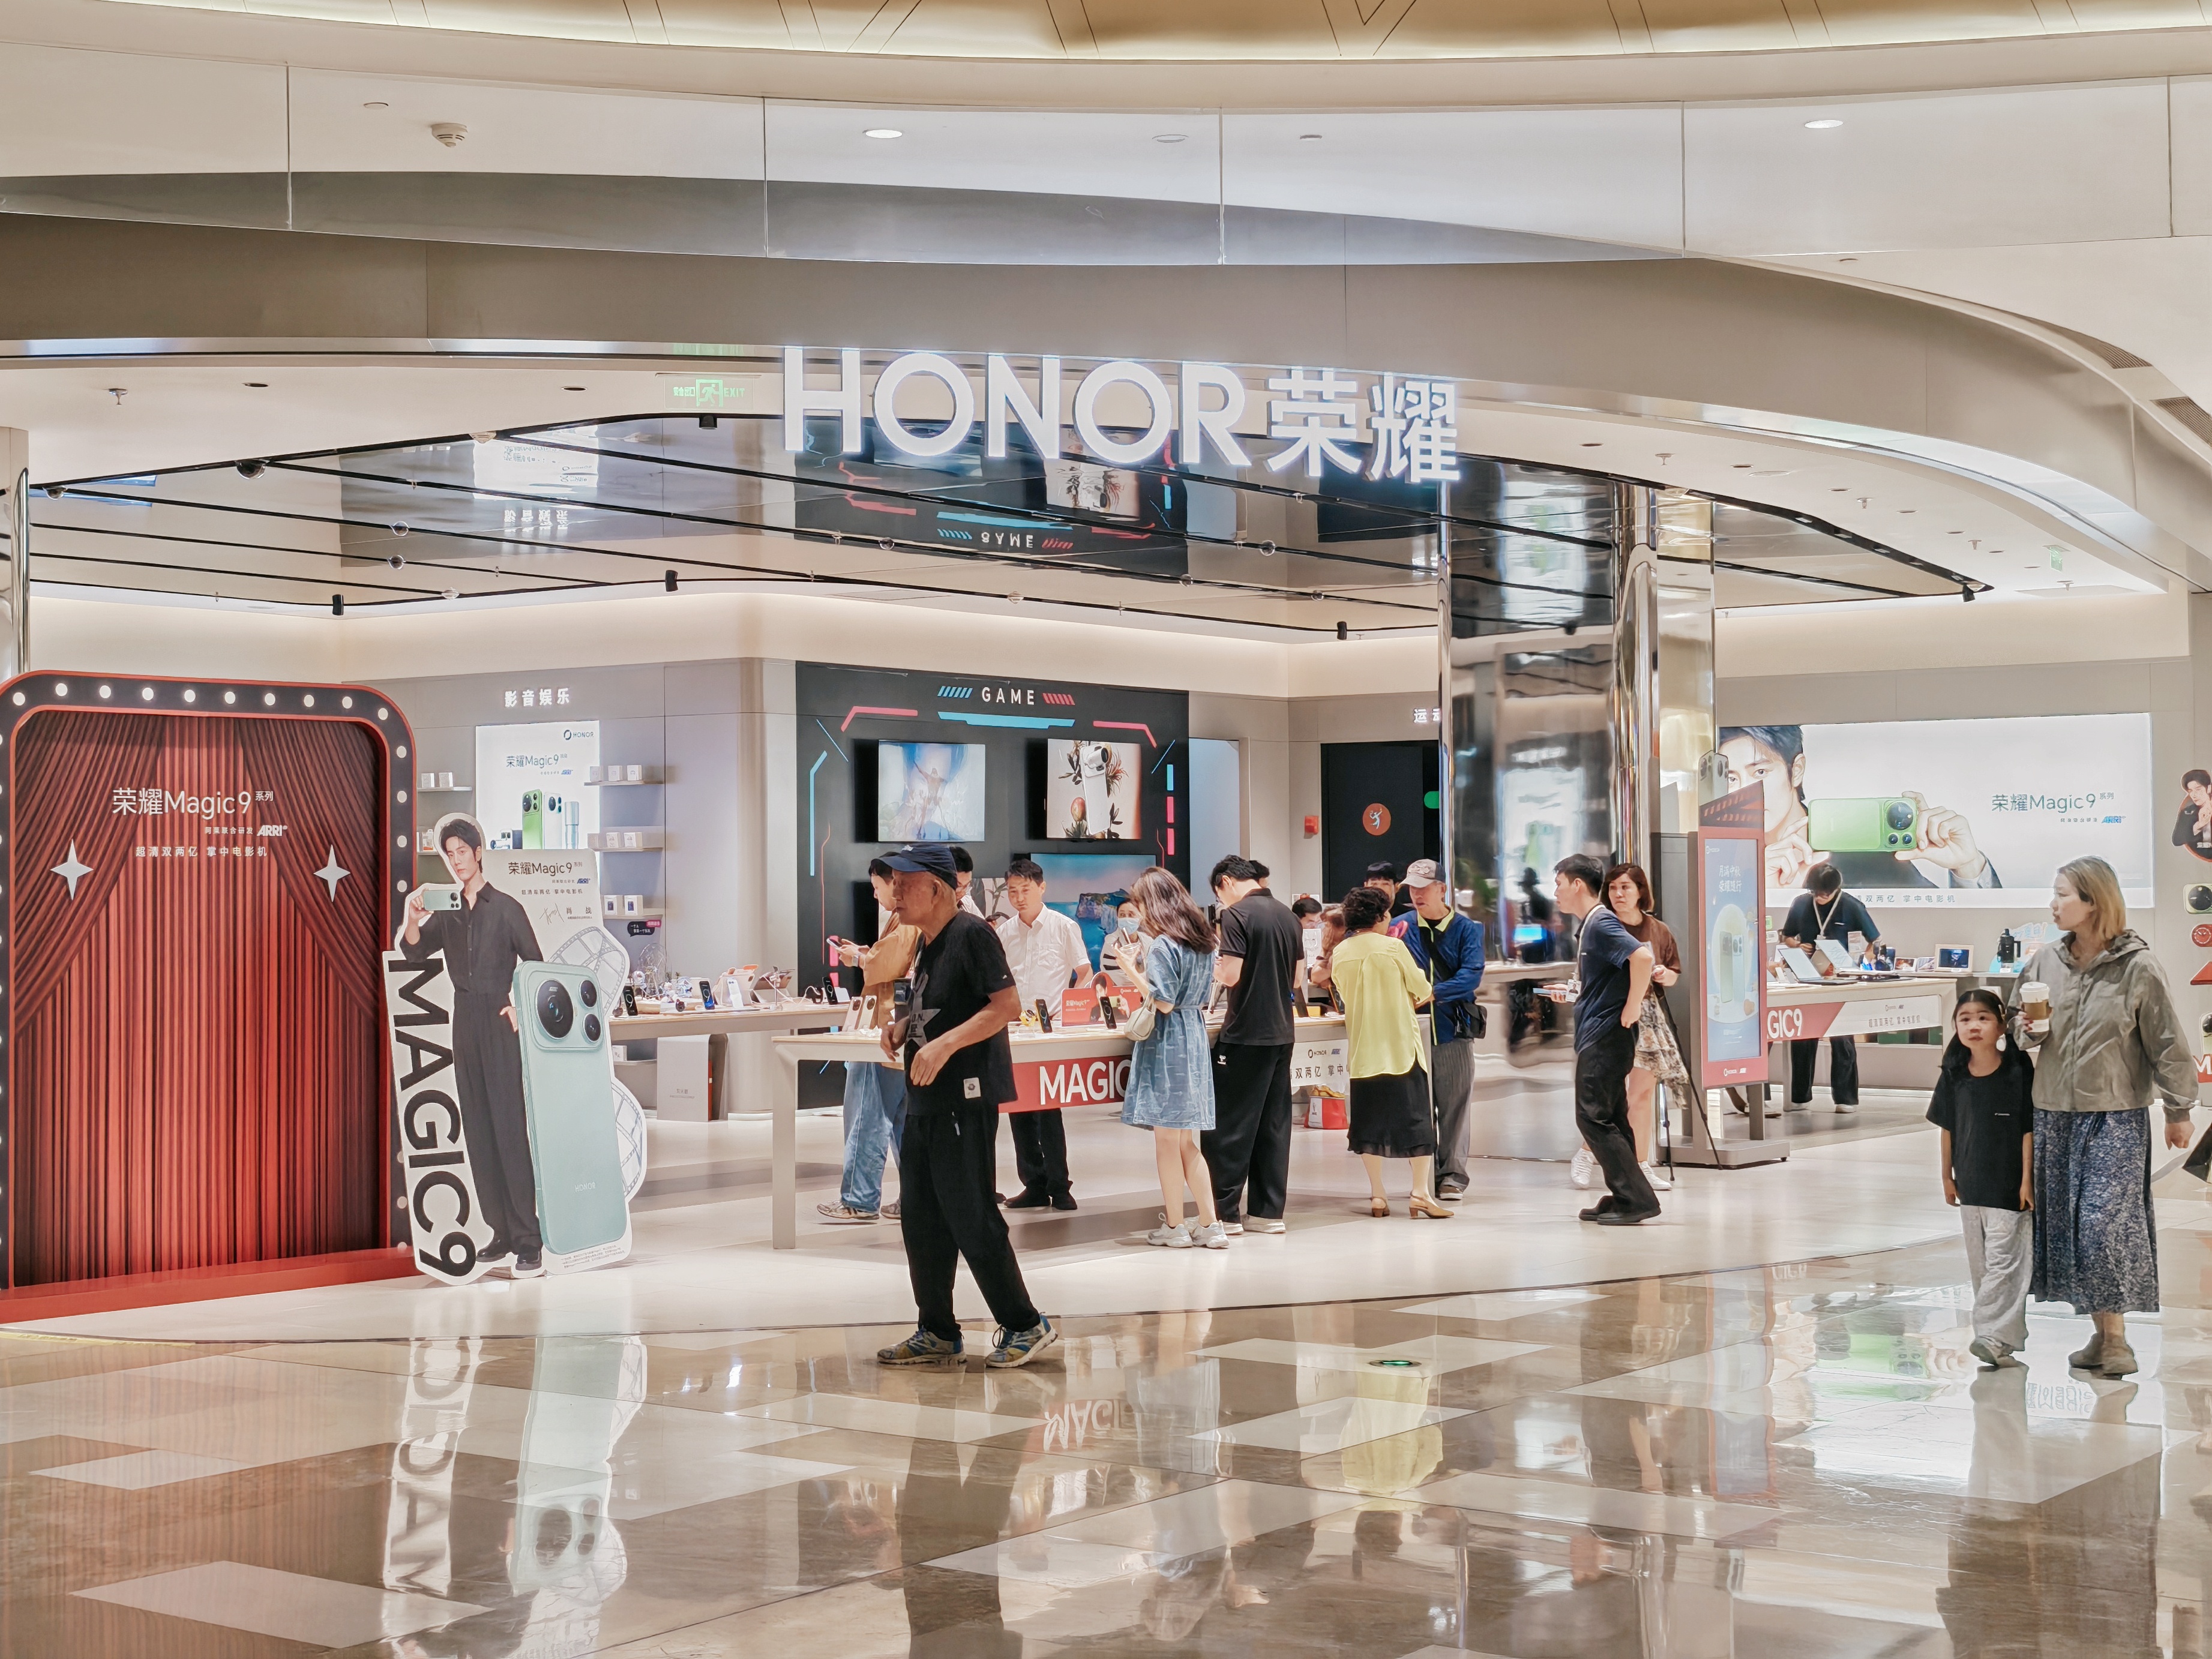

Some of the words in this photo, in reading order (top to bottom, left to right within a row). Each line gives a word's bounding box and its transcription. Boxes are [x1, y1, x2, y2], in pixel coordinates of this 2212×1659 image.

[724, 388, 745, 397] EXIT
[783, 347, 1251, 467] HONOR
[1266, 367, 1462, 482] 荣耀
[505, 688, 570, 707] 影音娱乐
[982, 686, 1034, 705] GAME
[255, 791, 274, 802] 系列
[136, 847, 197, 857] 超清双两亿
[207, 846, 268, 857] 掌中电影机
[1767, 1008, 1803, 1039] GIC9
[1290, 1066, 1321, 1079] 双两亿
[1327, 1064, 1349, 1076] 掌中
[388, 958, 478, 1277] MAGIC9
